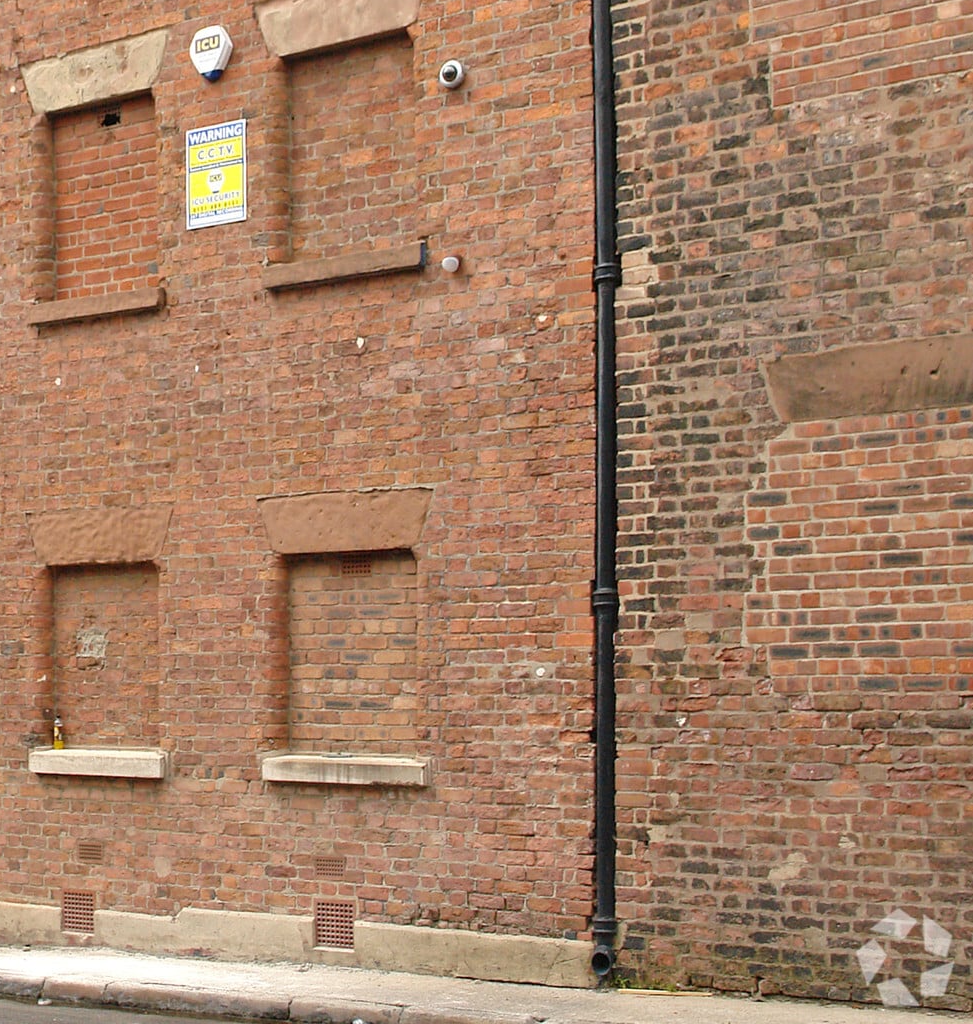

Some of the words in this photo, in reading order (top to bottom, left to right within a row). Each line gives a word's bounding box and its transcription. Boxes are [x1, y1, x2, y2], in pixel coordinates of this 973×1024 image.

[196, 36, 219, 52] ICU
[189, 124, 242, 145] WARNING
[209, 174, 222, 182] ICU
[206, 191, 240, 203] SECURITY
